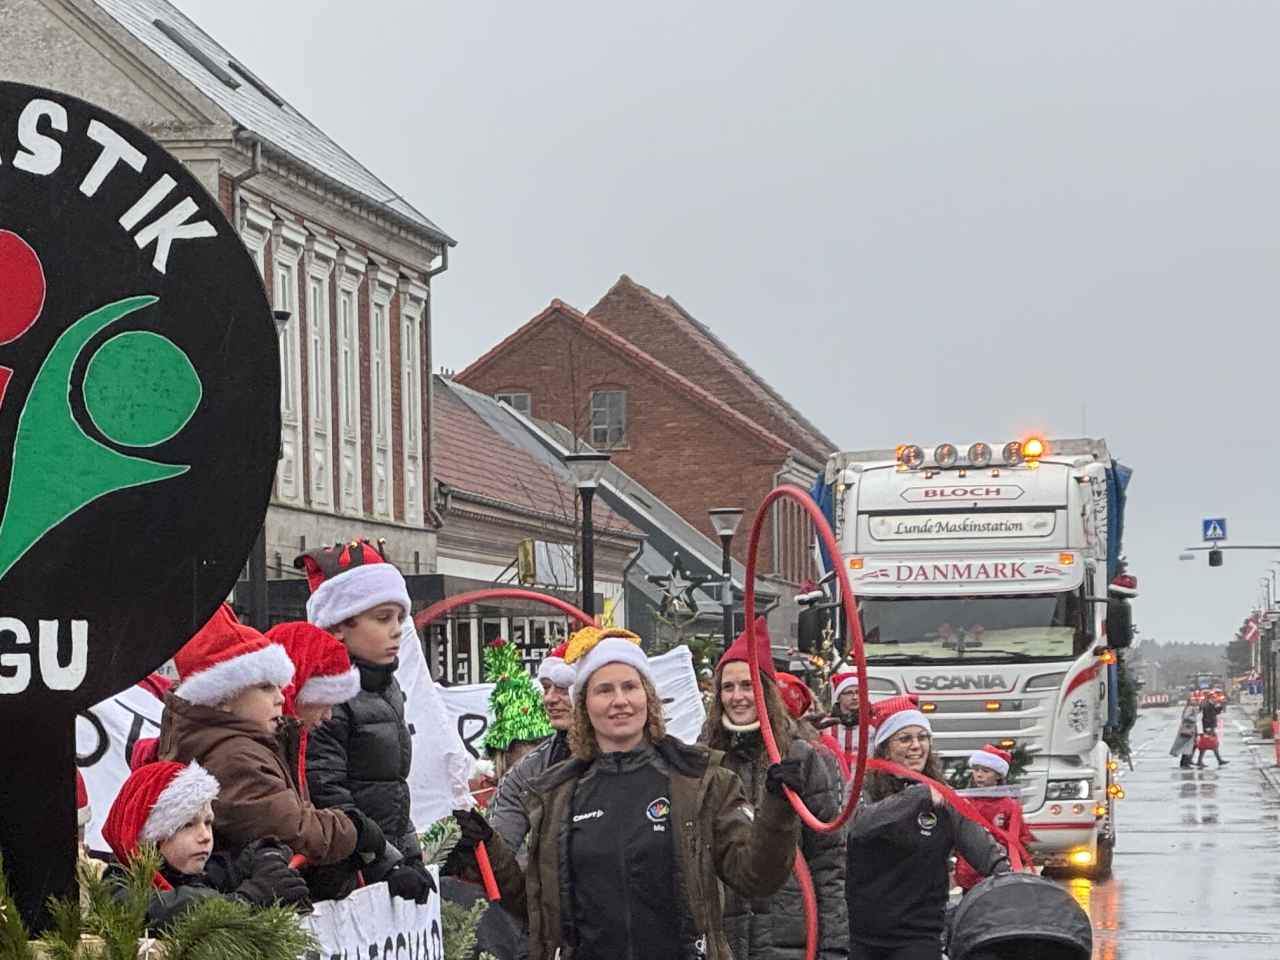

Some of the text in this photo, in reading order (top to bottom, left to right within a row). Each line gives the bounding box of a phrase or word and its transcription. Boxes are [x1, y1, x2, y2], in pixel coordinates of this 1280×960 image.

[923, 487, 1001, 498] BLOCH
[894, 519, 933, 535] Lunde
[934, 517, 1023, 533] Maskinstation
[895, 561, 1026, 582] DANMARK
[915, 674, 1008, 691] SCANIA
